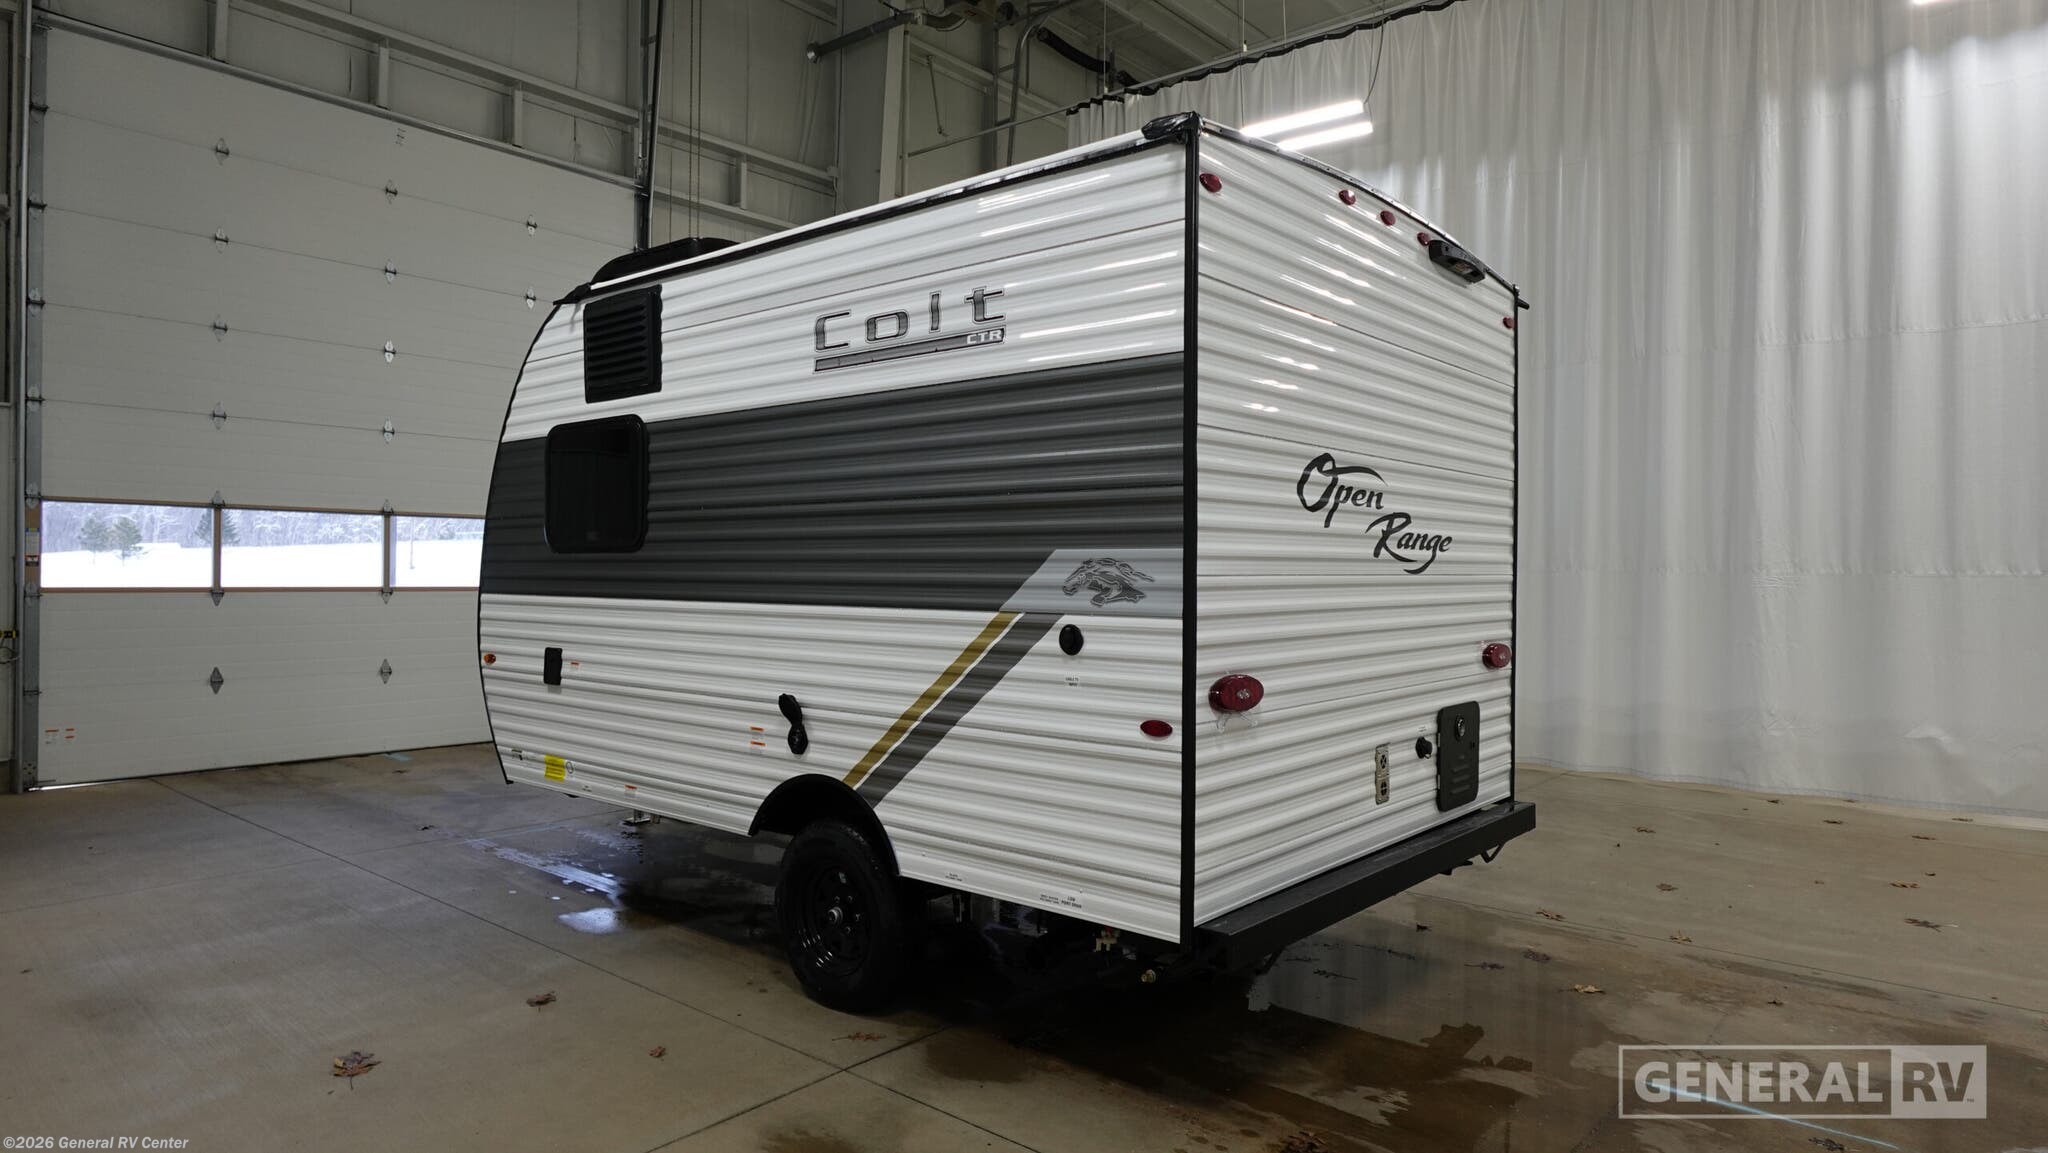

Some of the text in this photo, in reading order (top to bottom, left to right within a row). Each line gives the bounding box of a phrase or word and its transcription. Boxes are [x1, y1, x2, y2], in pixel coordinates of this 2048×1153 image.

[815, 286, 1006, 352] Colt
[966, 329, 1003, 345] CTR
[1296, 452, 1389, 529] Open
[1365, 511, 1453, 575] Range
